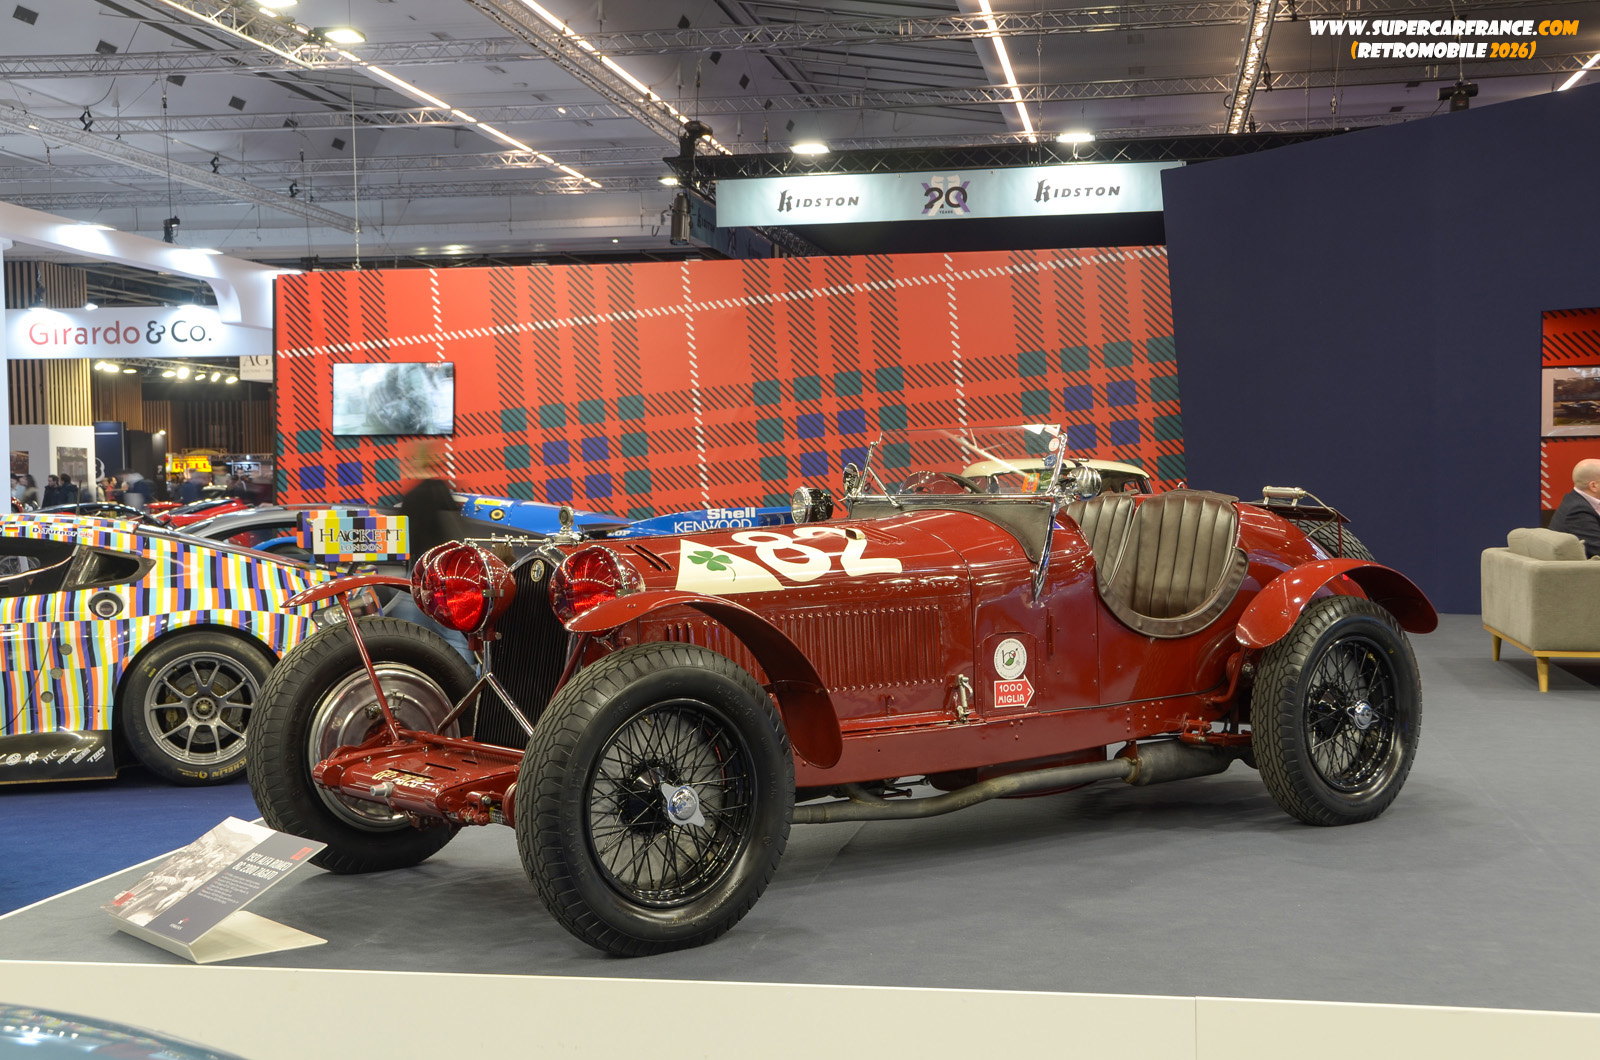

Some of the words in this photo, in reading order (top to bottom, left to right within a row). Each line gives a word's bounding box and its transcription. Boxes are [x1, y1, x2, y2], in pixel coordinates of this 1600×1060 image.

[29, 320, 141, 345] Girardo
[146, 320, 166, 345] &
[171, 320, 212, 343] Co.
[707, 507, 756, 520] Shell
[674, 519, 752, 534] KENWOOD
[320, 528, 403, 543] HACKETT
[340, 543, 383, 552] LONDON
[731, 527, 902, 582] 82
[999, 683, 1023, 693] 1000
[998, 693, 1025, 704] MIGLIA
